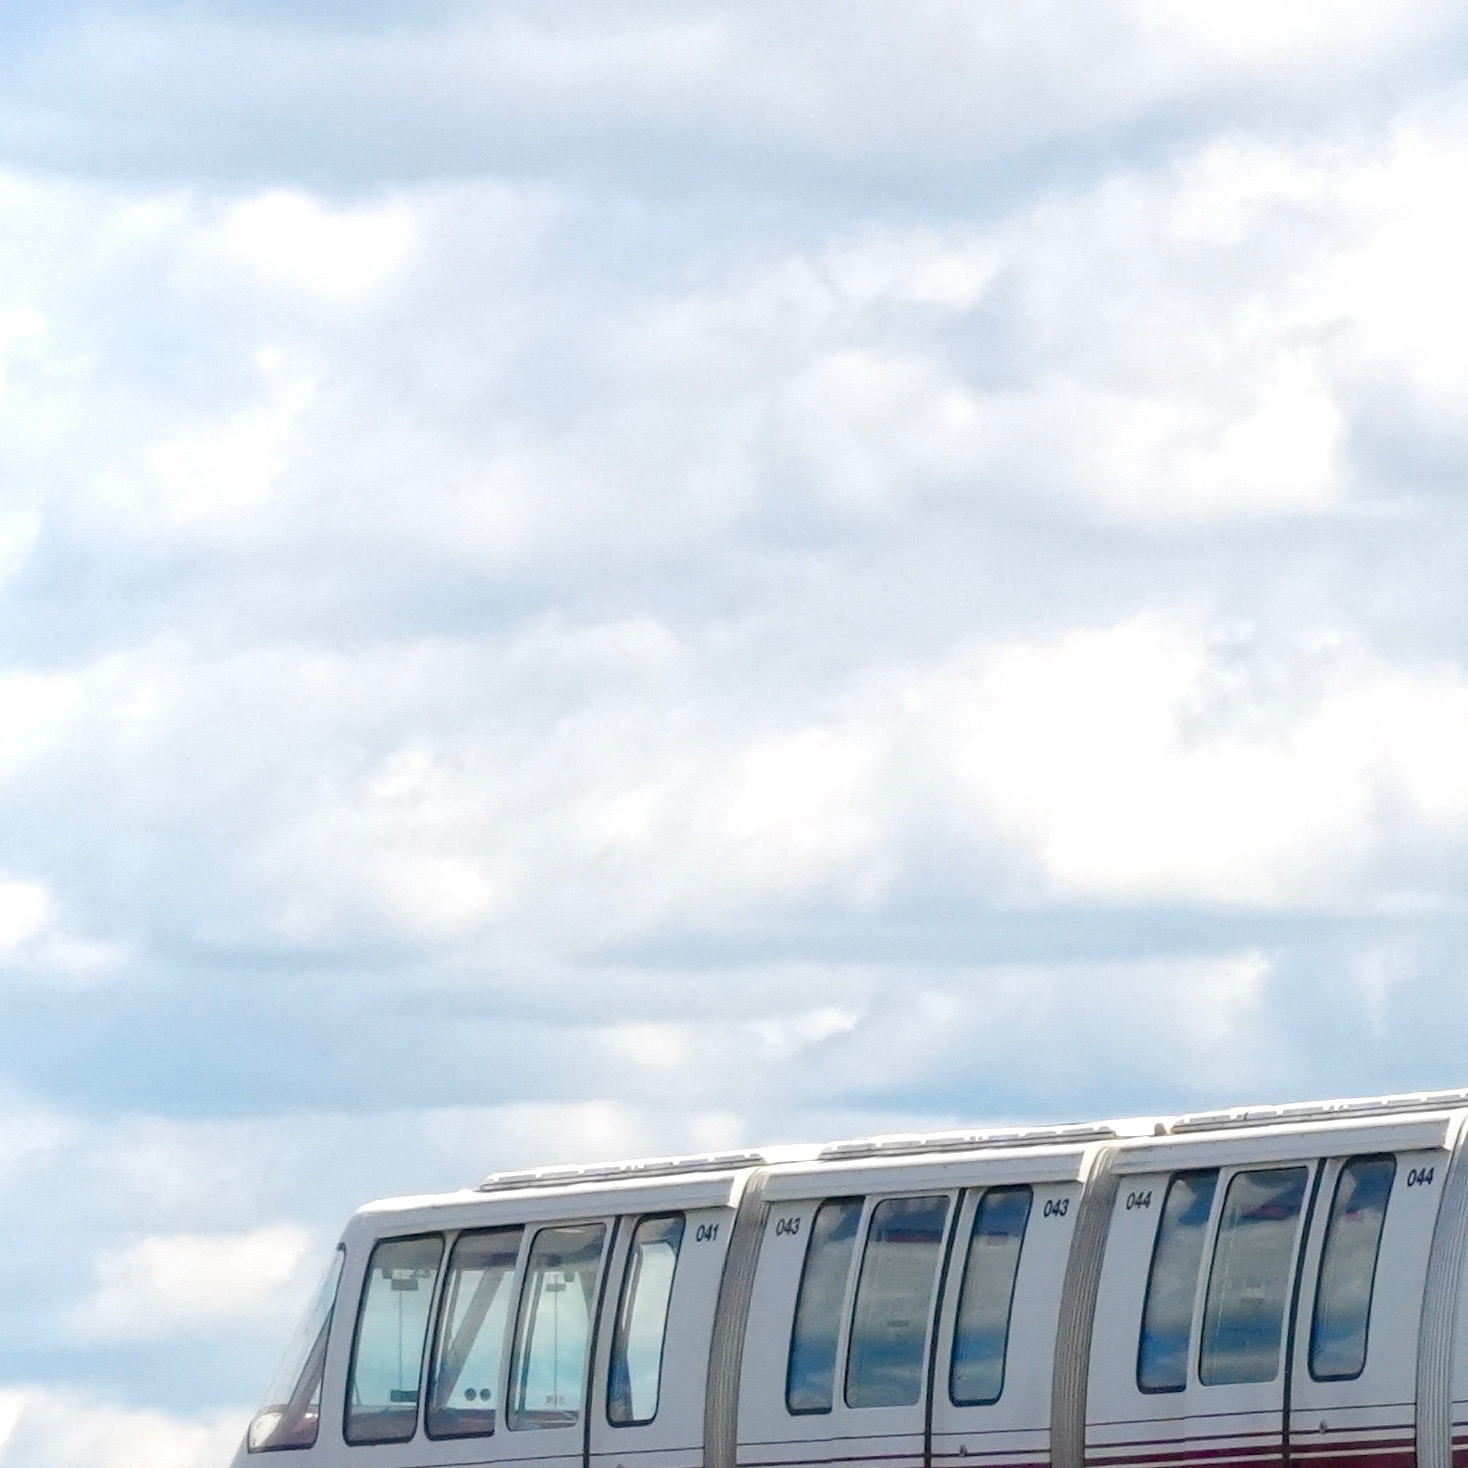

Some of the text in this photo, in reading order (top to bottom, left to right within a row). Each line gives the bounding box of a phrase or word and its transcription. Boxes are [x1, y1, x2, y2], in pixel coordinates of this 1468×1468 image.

[1407, 1167, 1434, 1187] 044
[1043, 1198, 1069, 1217] 043
[1126, 1191, 1152, 1210] 044
[696, 1223, 719, 1242] 041
[775, 1217, 800, 1237] 043
